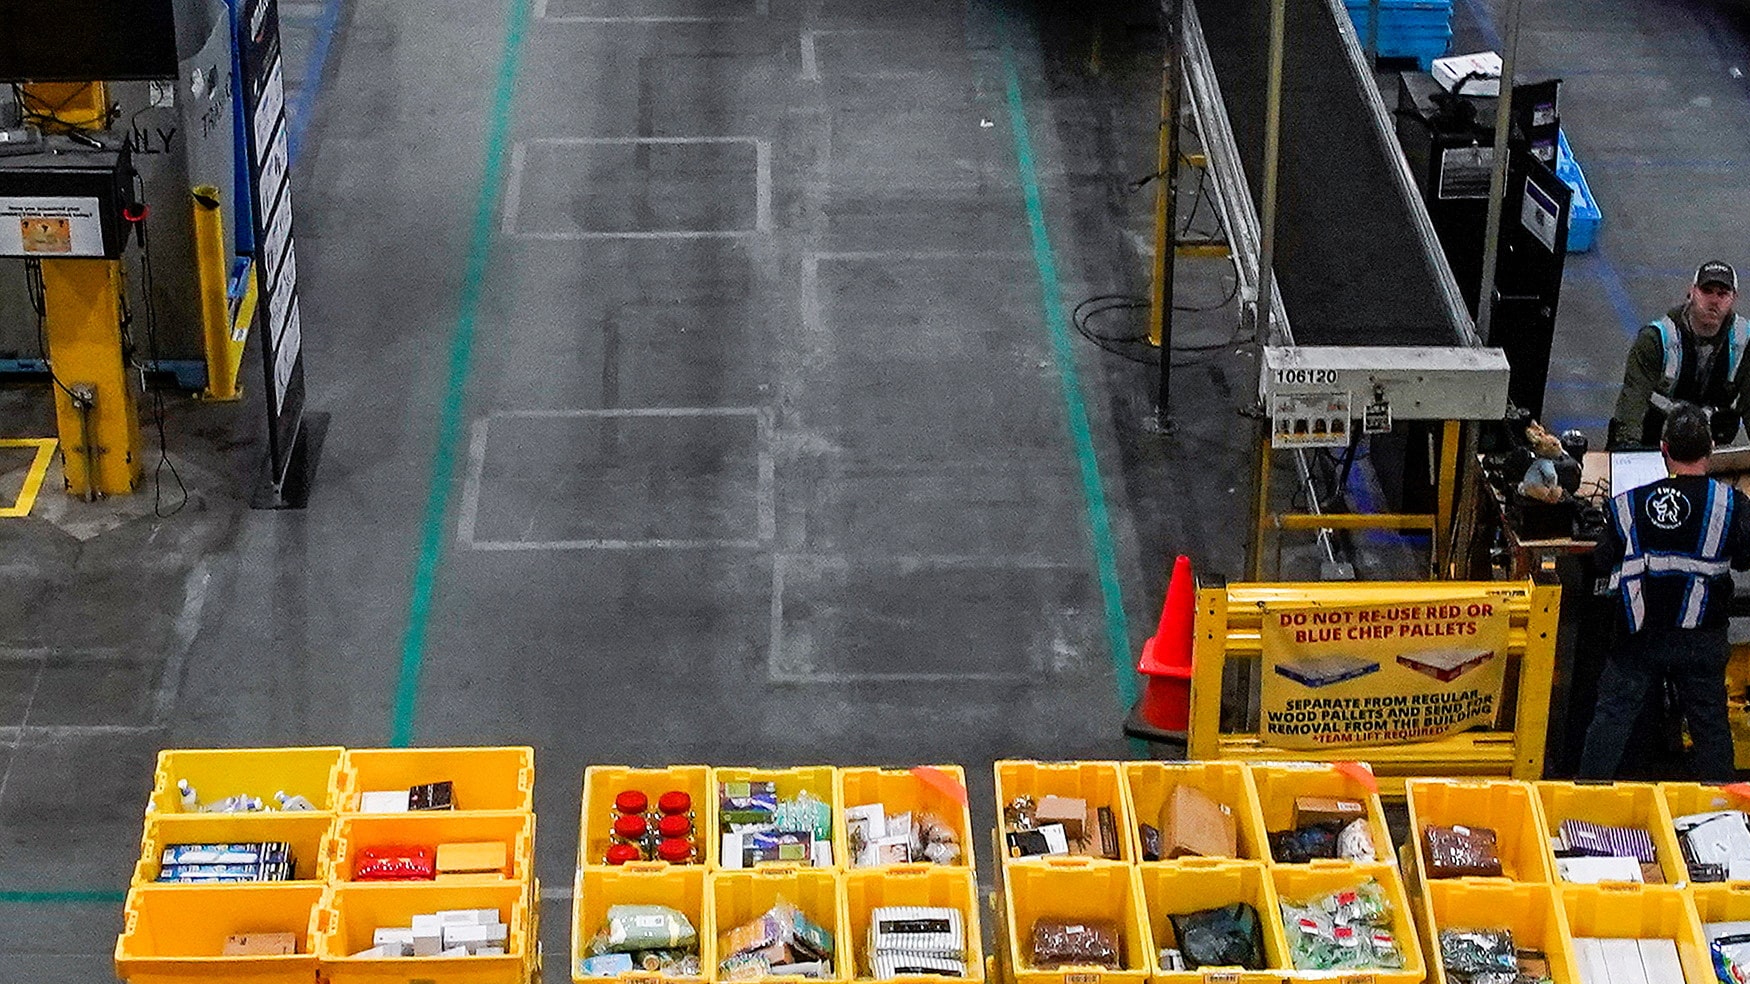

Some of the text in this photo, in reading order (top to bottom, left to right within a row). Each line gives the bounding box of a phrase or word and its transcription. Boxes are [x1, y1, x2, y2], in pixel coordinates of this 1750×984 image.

[1276, 369, 1337, 384] 106120
[1280, 603, 1494, 627] DO NOT RE-USE RED OR
[1295, 621, 1478, 643] BLUE CHEP PALLETS
[1268, 694, 1494, 723] WOOD PALLETS AND SEND FOR
[1286, 689, 1480, 712] SEPARATE FROM REGULAR
[1267, 705, 1493, 735] REMOVAL FROM THE BUILDING
[1356, 730, 1381, 742] LIFT
